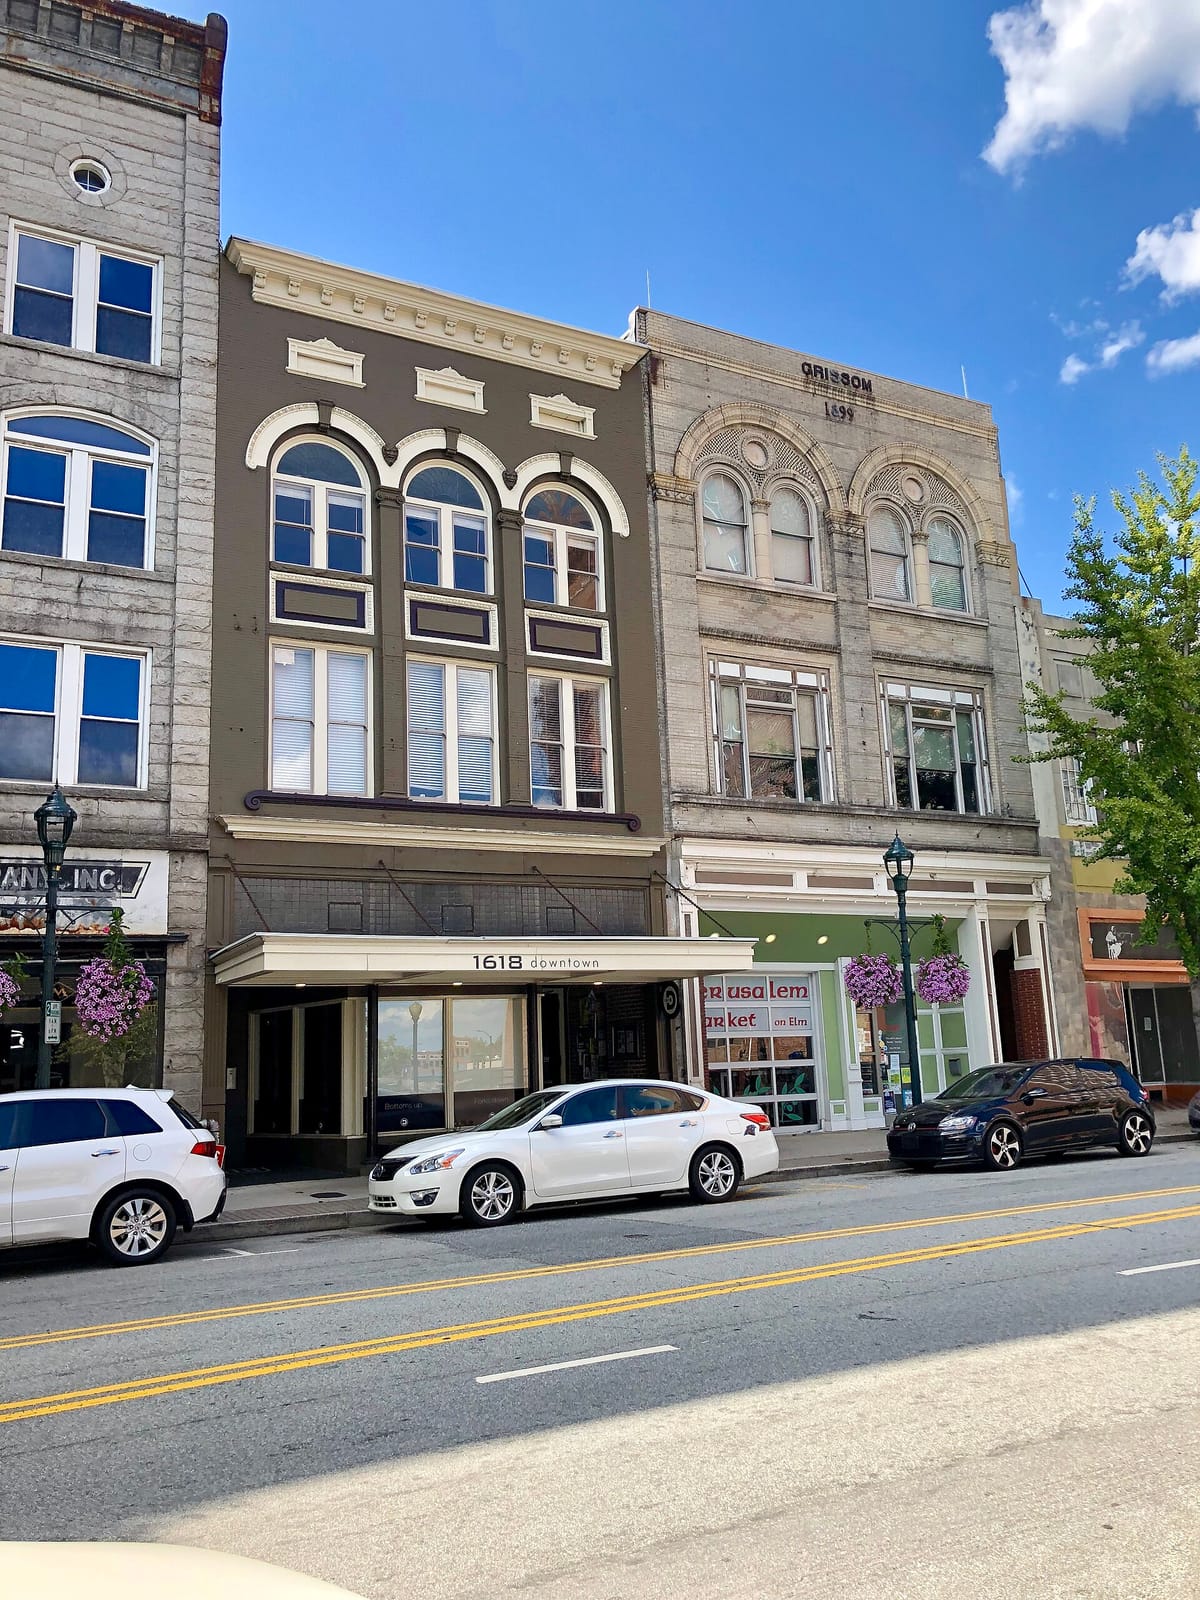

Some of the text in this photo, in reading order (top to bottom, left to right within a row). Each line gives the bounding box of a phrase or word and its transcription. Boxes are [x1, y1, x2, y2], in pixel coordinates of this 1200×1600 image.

[801, 361, 873, 392] GRISSOM
[73, 868, 121, 891] INC.
[473, 955, 599, 970] 1618 downtown
[789, 1016, 808, 1026] Elm
